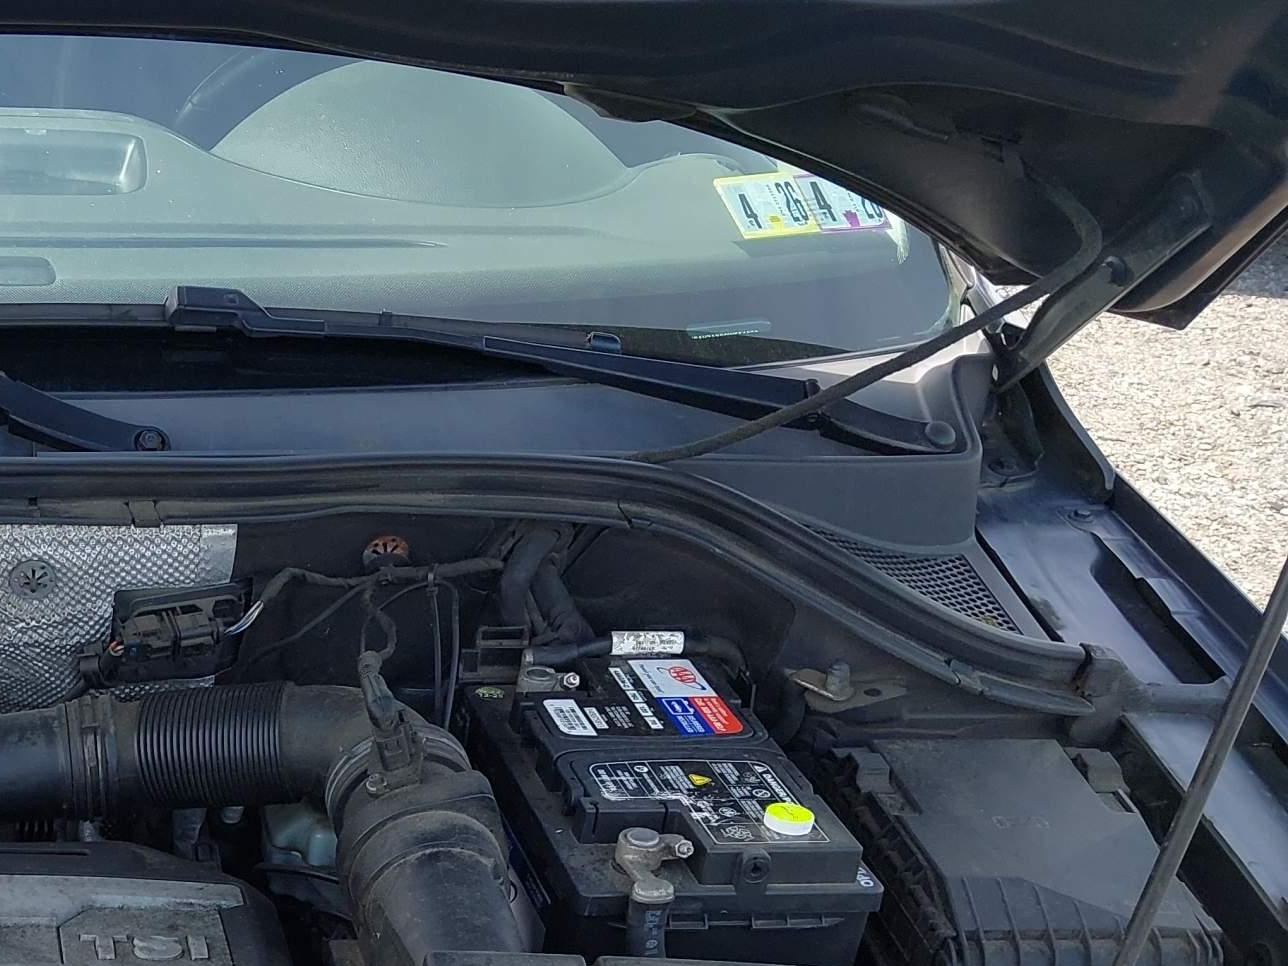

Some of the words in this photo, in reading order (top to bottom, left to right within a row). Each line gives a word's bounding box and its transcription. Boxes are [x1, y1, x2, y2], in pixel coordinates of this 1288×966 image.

[738, 193, 762, 229] 4
[774, 181, 810, 222] 26
[809, 181, 837, 222] 4
[78, 932, 210, 961] TSI
